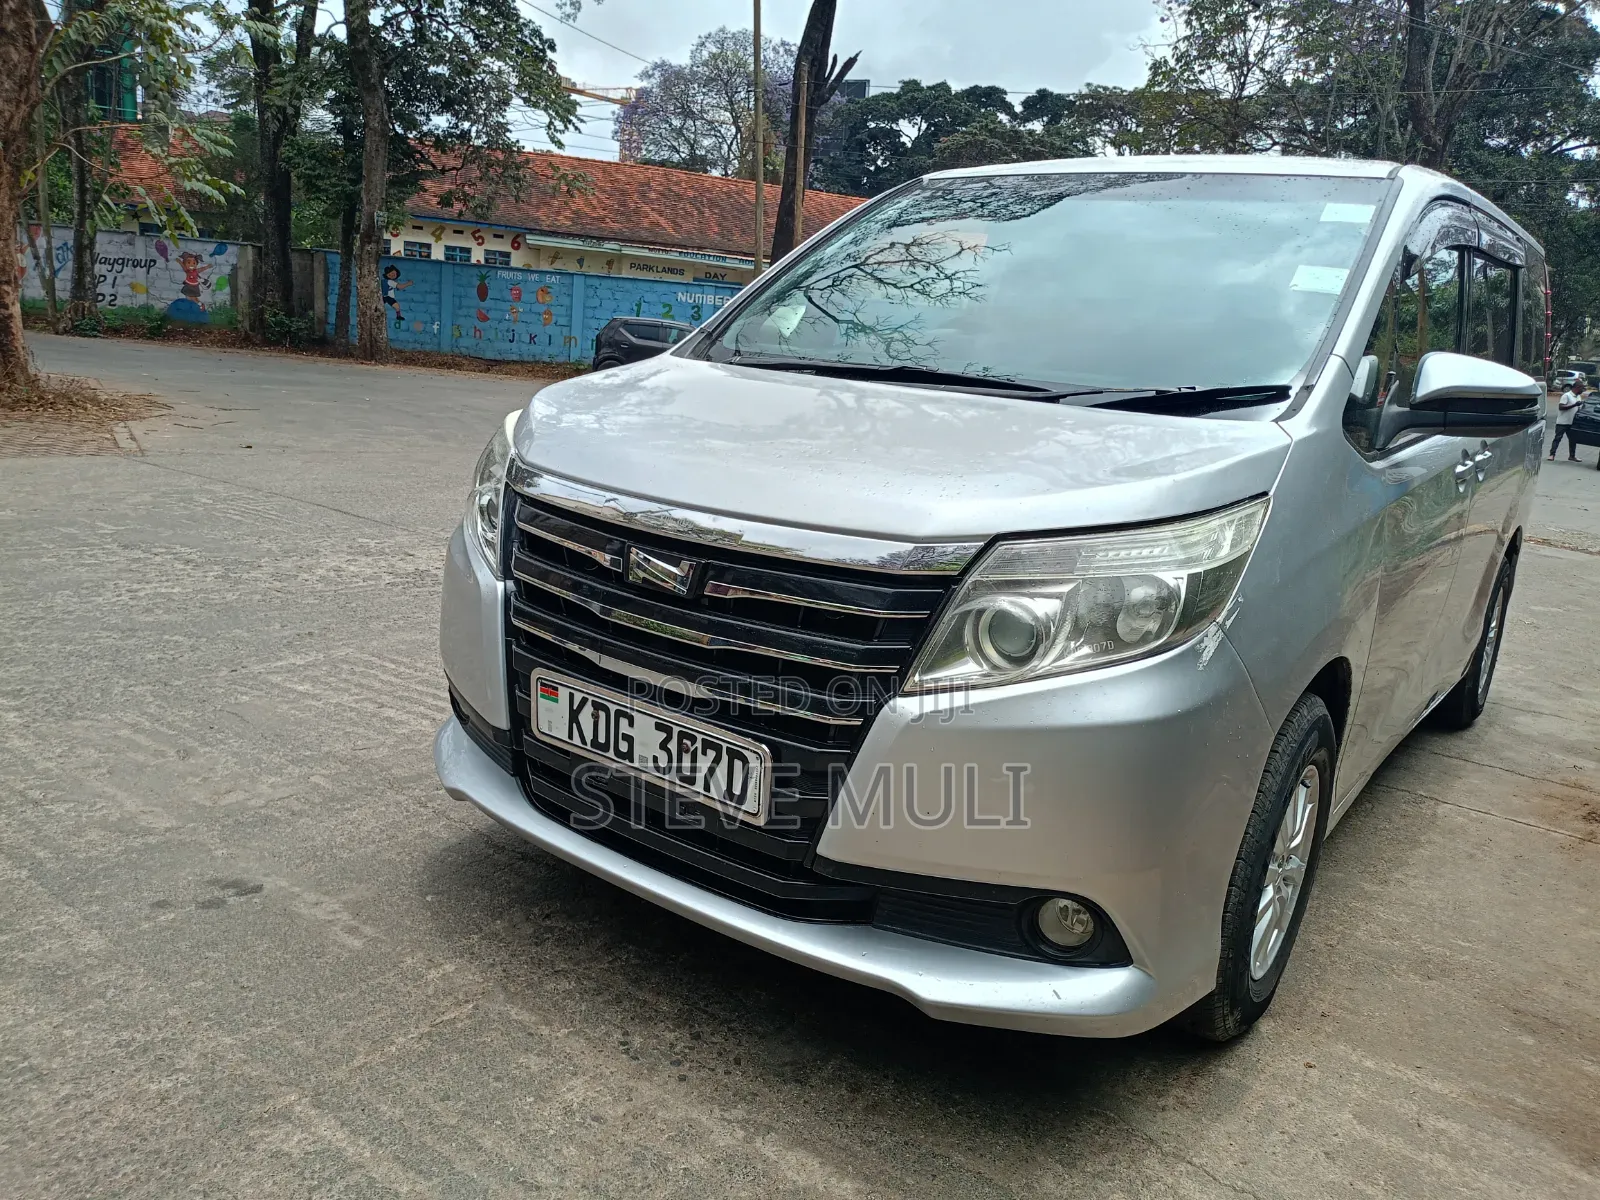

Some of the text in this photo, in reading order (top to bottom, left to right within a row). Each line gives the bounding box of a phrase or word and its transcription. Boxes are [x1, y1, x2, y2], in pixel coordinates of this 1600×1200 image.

[430, 225, 522, 250] 4 5 6
[94, 252, 157, 275] laygroup
[629, 262, 727, 281] PARKLANDS DAY
[497, 270, 561, 284] FRUITS WE EAT
[108, 293, 117, 307] 2
[661, 304, 675, 319] 2
[691, 305, 702, 321] 3
[473, 326, 482, 339] h
[568, 691, 635, 764] KDG
[652, 720, 750, 805] 307D
